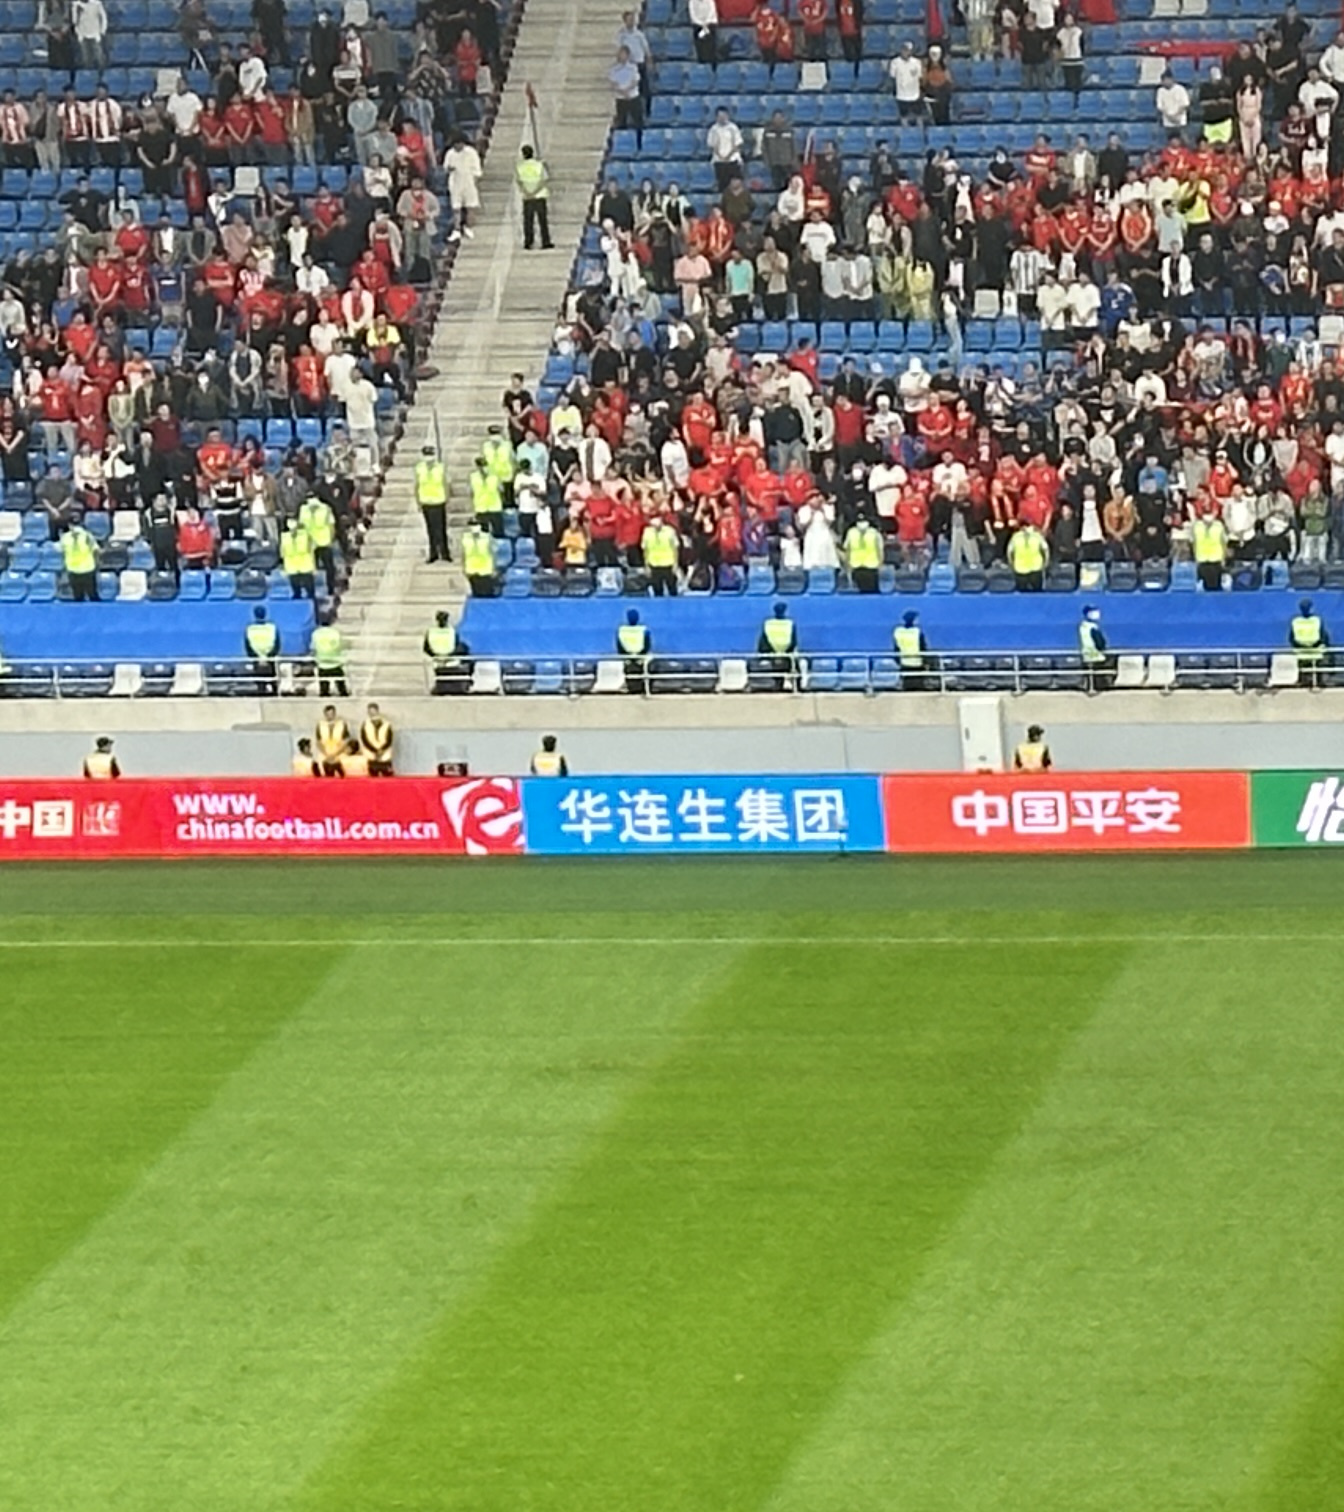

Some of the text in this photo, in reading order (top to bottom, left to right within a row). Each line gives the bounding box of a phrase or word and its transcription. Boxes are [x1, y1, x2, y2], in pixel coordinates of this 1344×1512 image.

[173, 793, 266, 816] www.
[558, 787, 847, 844] 华连生集团
[951, 787, 1182, 837] 中国平安
[176, 818, 440, 841] chinafootball.com.cn
